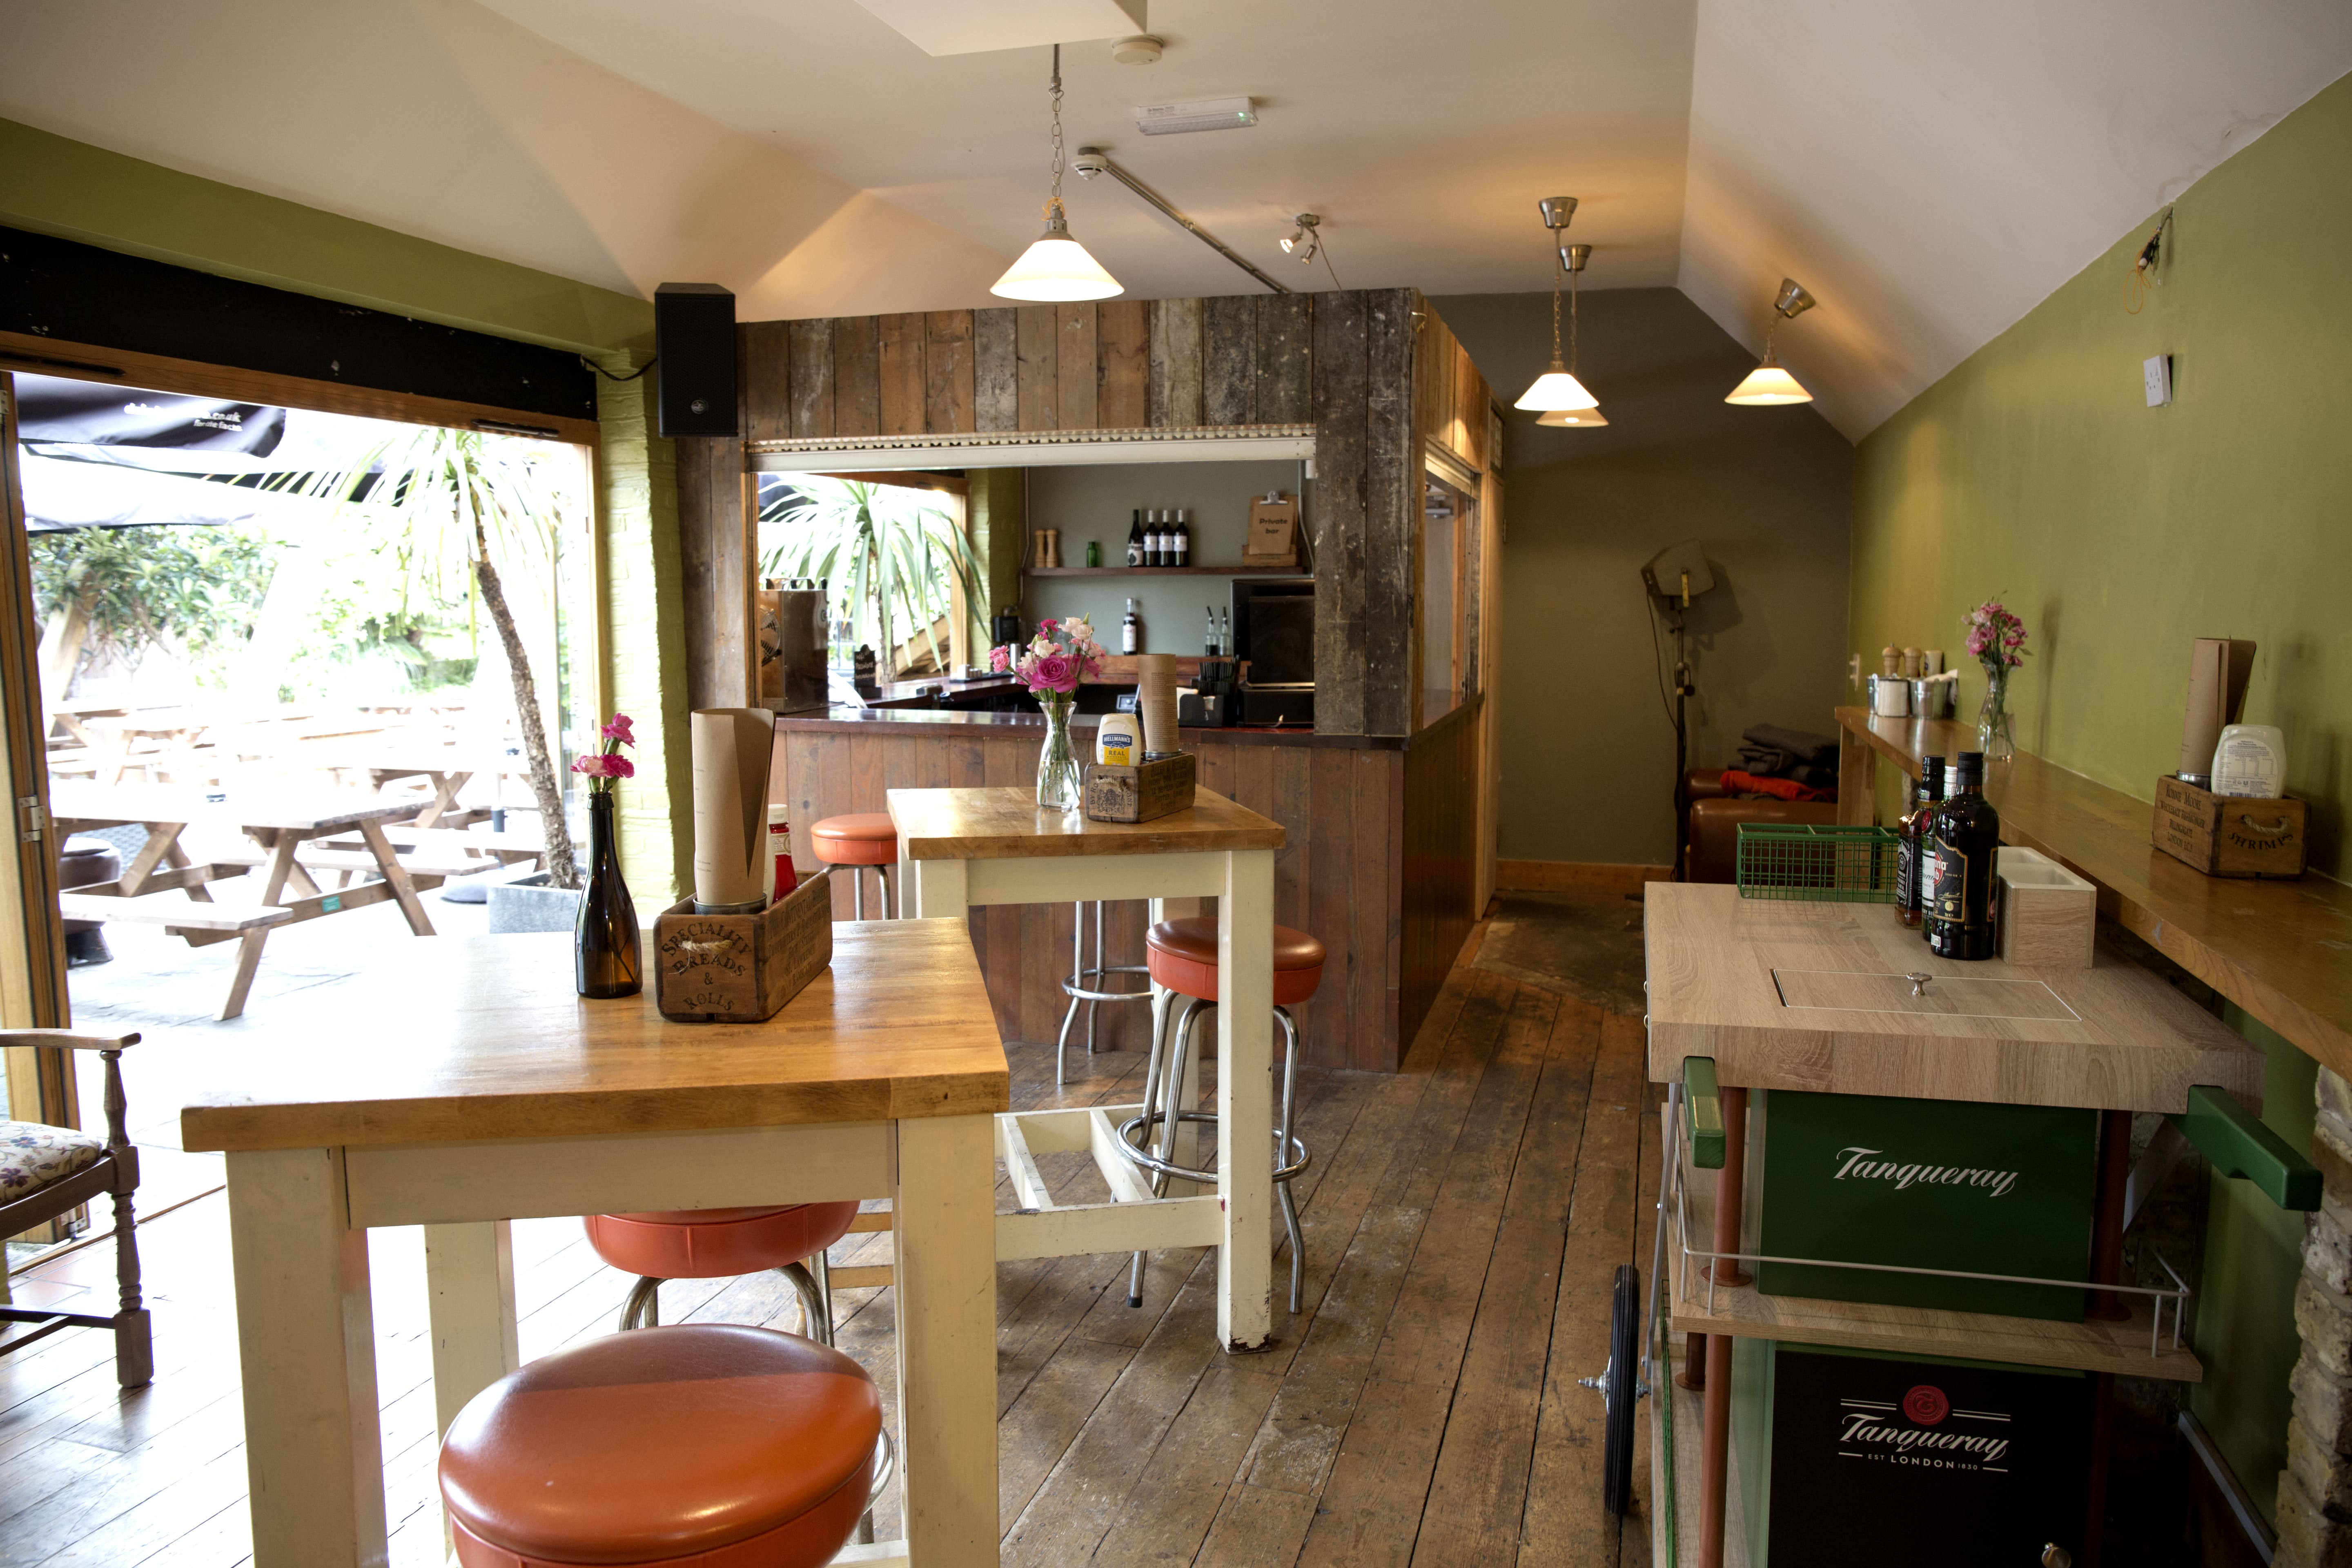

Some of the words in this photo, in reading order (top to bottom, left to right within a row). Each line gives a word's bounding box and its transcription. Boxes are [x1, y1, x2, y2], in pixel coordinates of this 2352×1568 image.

[2166, 784, 2182, 802] RONNIE
[2184, 792, 2201, 811] MOORE
[2160, 800, 2180, 817] WHOLESALE
[2181, 810, 2205, 829] FISHMONGER
[2168, 831, 2183, 847] LONDON
[2228, 832, 2293, 849] SHRIMPS
[662, 922, 751, 956] SPECIALITY
[802, 931, 814, 948] STREET
[672, 953, 746, 976] BREADS
[795, 943, 815, 968] LAWRENCE
[704, 972, 713, 985] &
[792, 961, 811, 986] RAMSGATE
[683, 993, 735, 1011] ROLLS
[1833, 1147, 2018, 1197] Tanqueray
[1840, 1413, 2009, 1461] Tanqueray
[1891, 1454, 1954, 1469] LONDON
